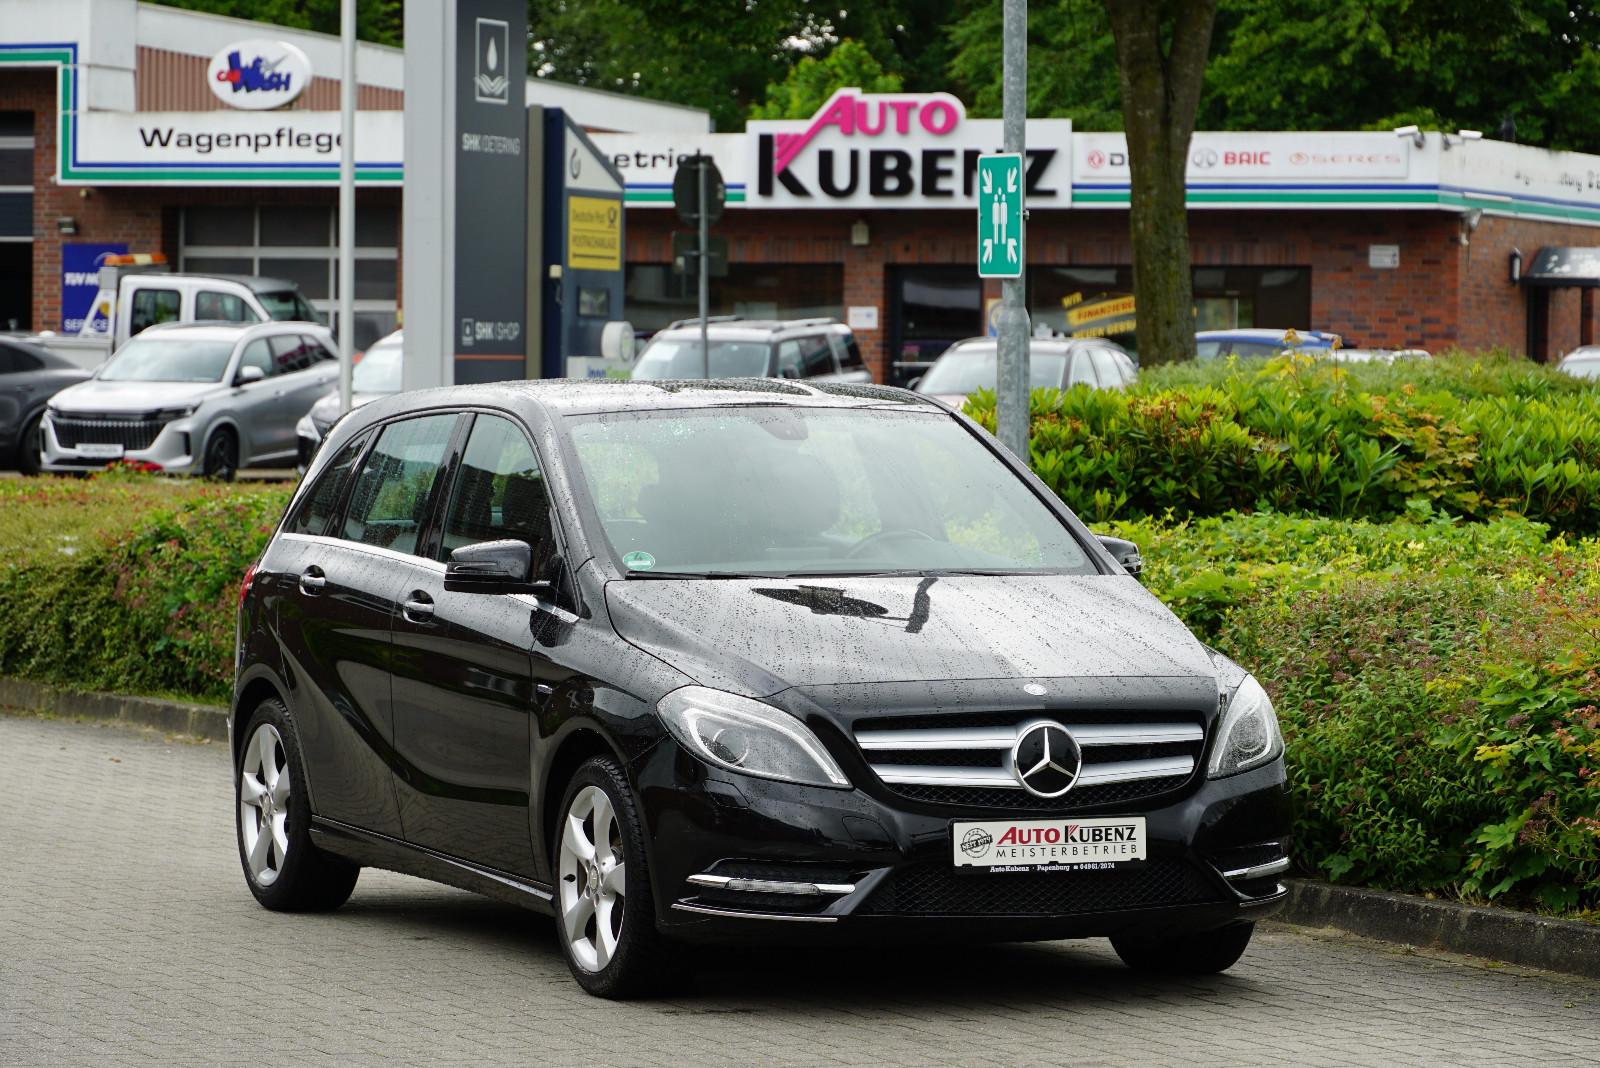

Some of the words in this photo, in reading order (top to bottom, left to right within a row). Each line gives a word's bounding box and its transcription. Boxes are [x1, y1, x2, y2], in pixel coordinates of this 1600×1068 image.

[800, 95, 959, 138] AUTO
[1223, 151, 1271, 166] BAIC
[1077, 300, 1136, 320] FINANZIERE
[997, 826, 1060, 845] AUTO
[1064, 825, 1137, 844] KUBENZ
[996, 845, 1137, 858] MEISTERBETRIEB
